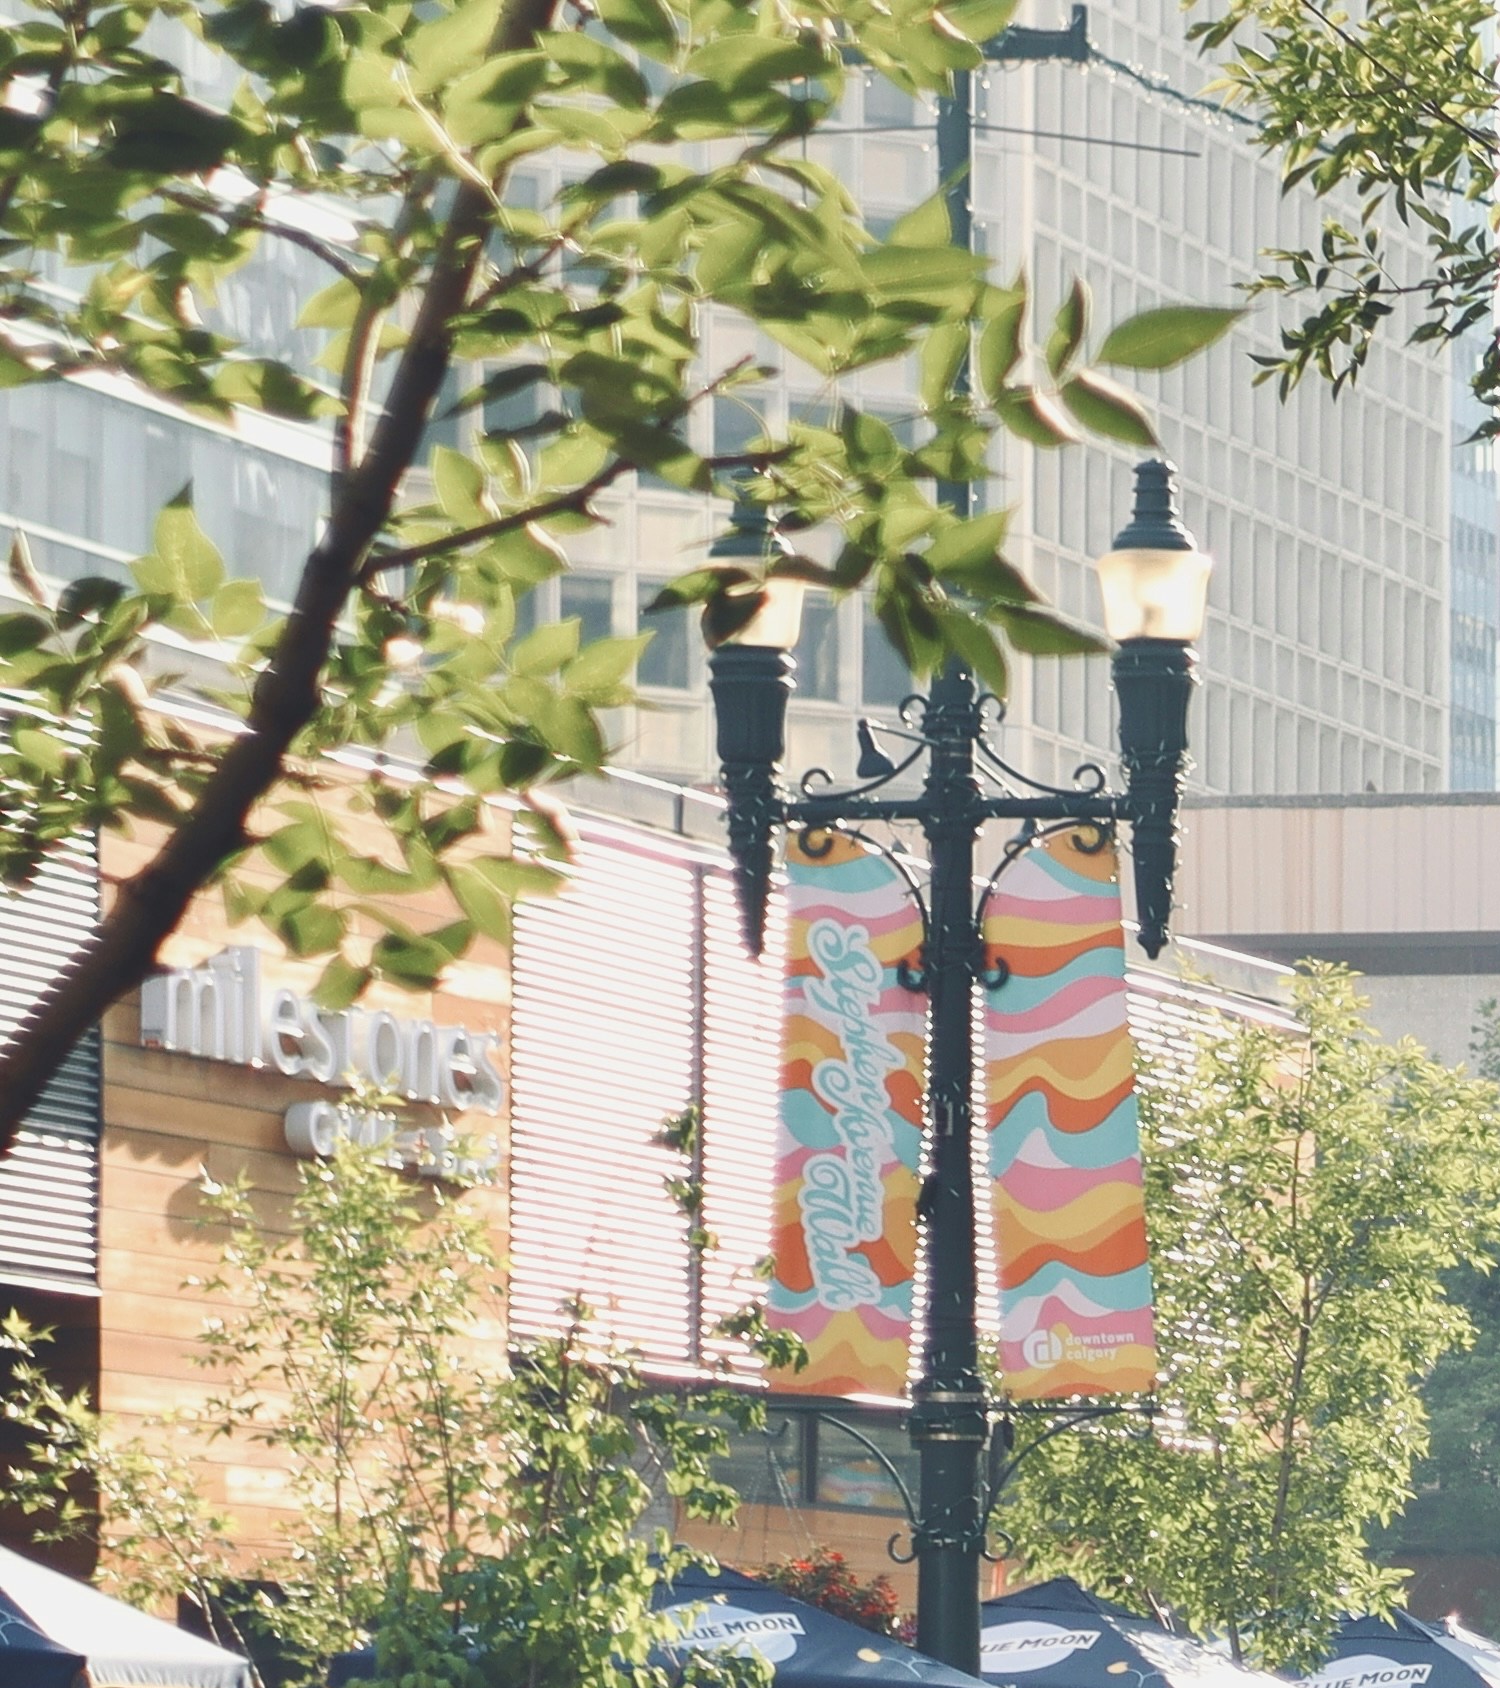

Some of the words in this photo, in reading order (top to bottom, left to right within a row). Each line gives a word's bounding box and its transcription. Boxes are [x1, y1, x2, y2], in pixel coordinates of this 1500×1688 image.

[806, 924, 900, 1102] Stephen
[141, 945, 503, 1117] milestones
[805, 1157, 879, 1304] Walk
[1064, 1332, 1135, 1346] downtown
[1066, 1346, 1118, 1362] calgary
[679, 1626, 723, 1642] LUE
[724, 1616, 798, 1636] MOON
[1018, 1634, 1095, 1650] MOON
[1358, 1667, 1428, 1687] MOON
